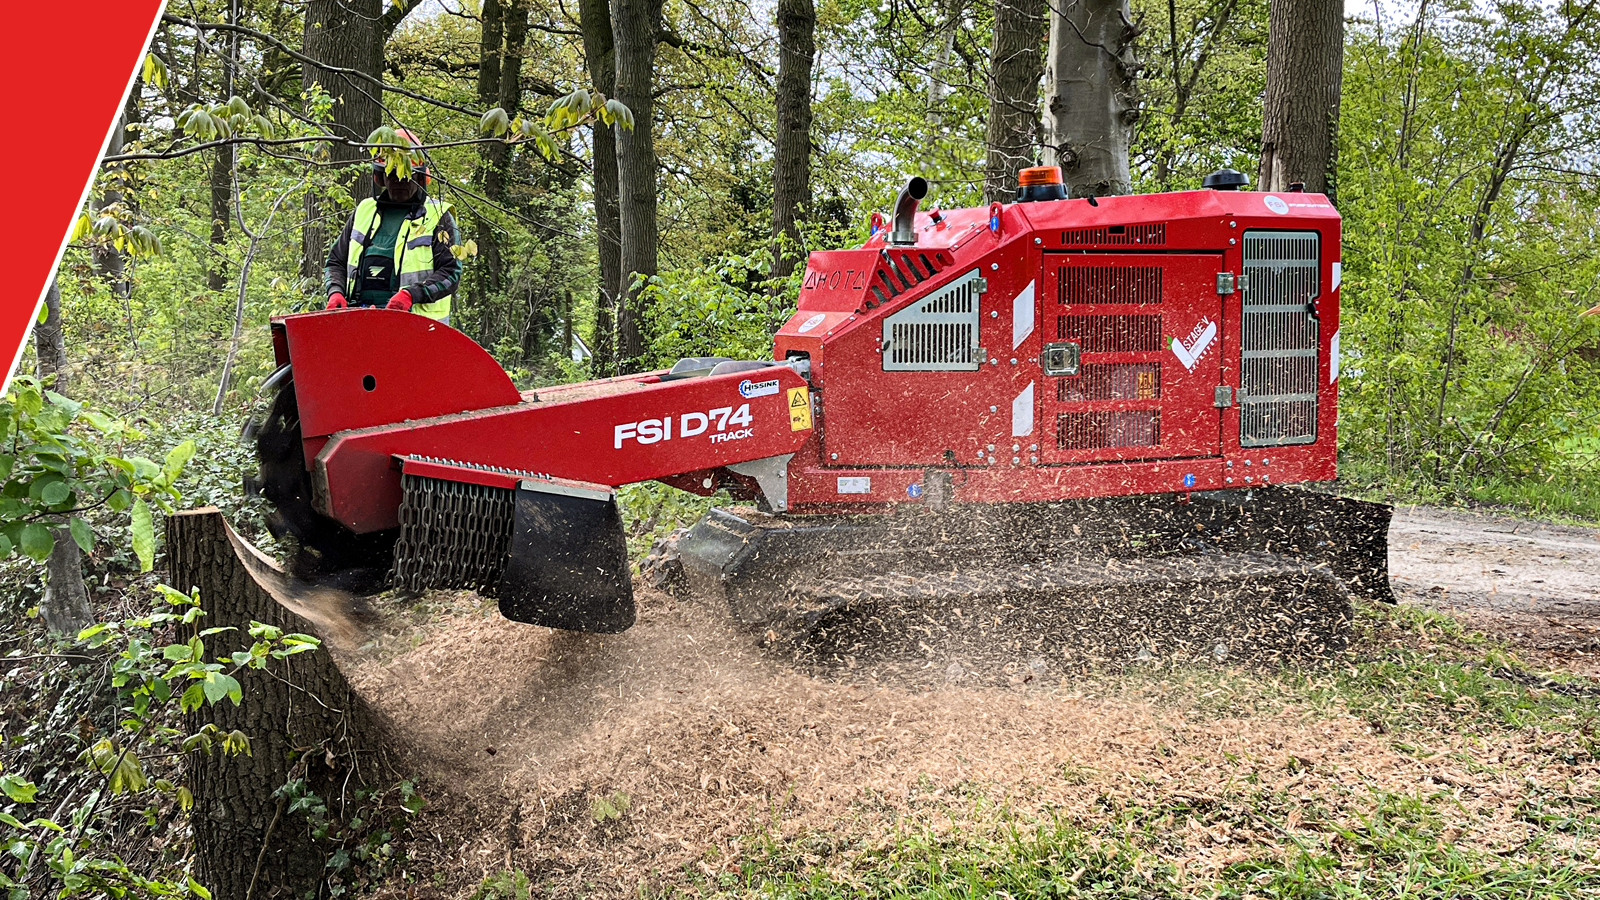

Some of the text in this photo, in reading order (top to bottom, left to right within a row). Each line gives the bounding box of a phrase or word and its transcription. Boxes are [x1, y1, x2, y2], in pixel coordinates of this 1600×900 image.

[1183, 322, 1206, 350] STAGE
[1201, 315, 1210, 325] V
[614, 403, 753, 449] FSI D74
[709, 428, 754, 444] TRACK
